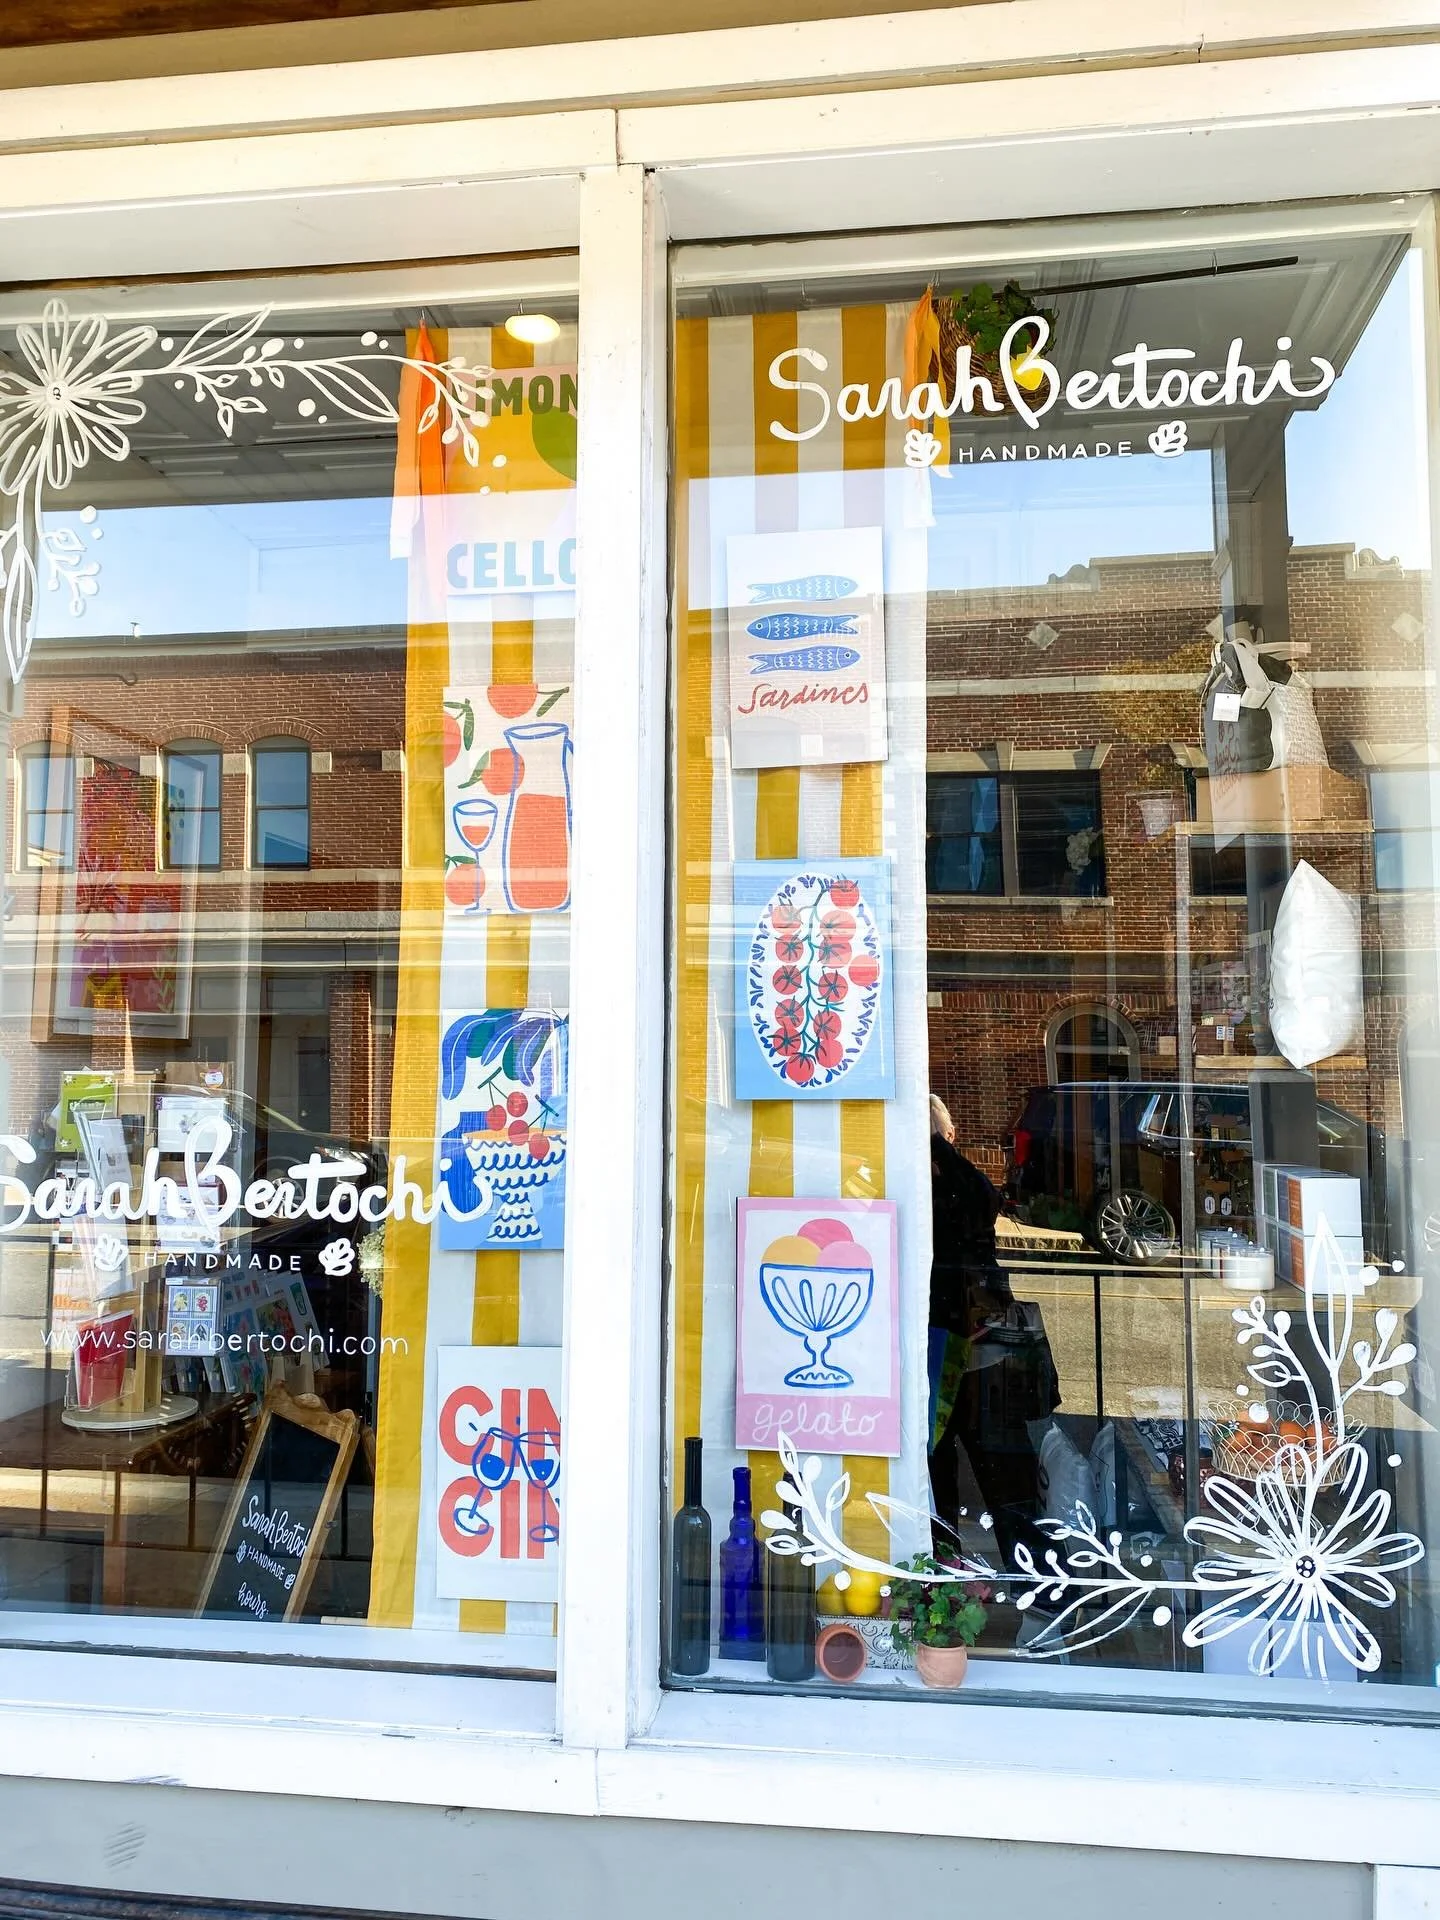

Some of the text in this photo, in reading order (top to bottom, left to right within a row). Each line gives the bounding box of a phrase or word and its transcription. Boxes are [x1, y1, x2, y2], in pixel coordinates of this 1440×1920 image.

[769, 315, 1336, 442] Sarah Bertochi
[958, 440, 1133, 464] HANDMADE
[737, 682, 869, 714] Sardines
[184, 1115, 494, 1244] Bertochi
[144, 1251, 302, 1271] HANDMADE
[39, 1327, 409, 1356] www.sarahbertochi.com
[751, 1401, 883, 1443] gelato
[274, 1510, 311, 1557] Bertoch
[246, 1546, 287, 1581] HANDMADE
